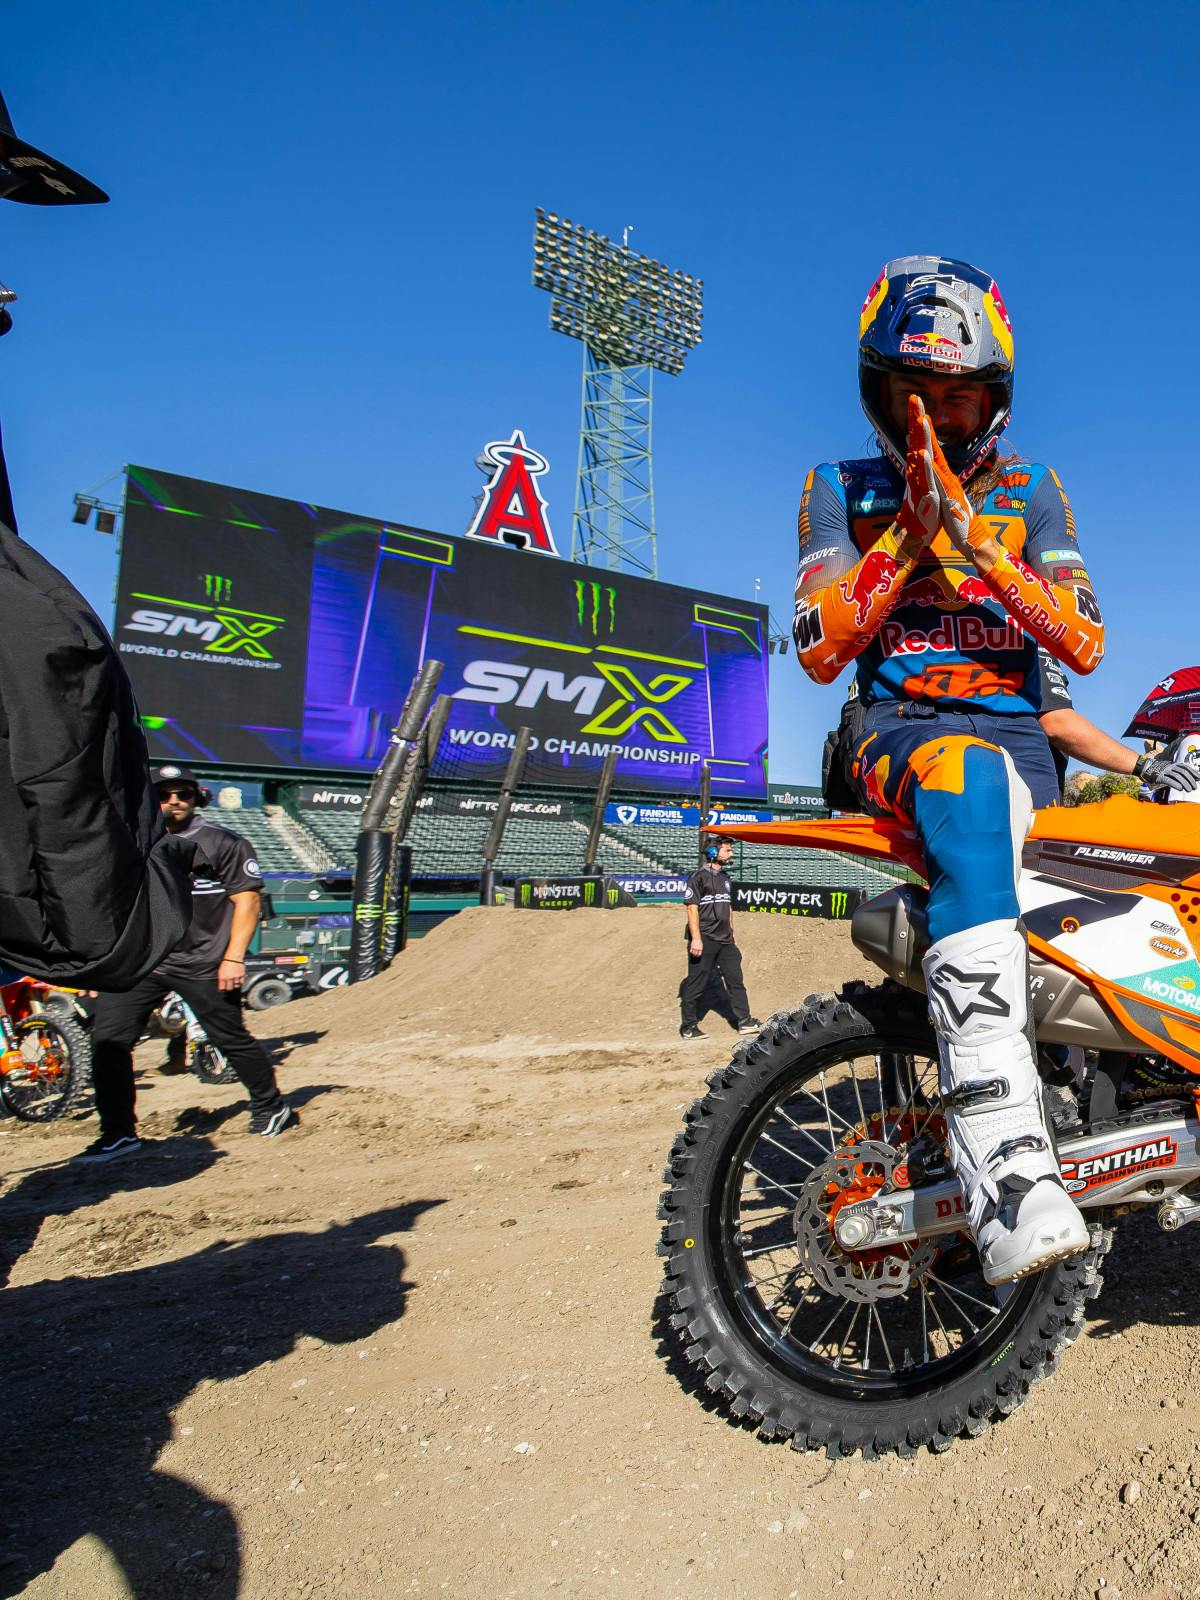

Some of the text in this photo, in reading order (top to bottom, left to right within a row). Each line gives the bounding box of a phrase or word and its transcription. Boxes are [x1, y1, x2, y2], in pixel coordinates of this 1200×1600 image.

[900, 344, 964, 360] Red Bull
[465, 429, 560, 557] A
[1001, 581, 1040, 620] Red
[1031, 608, 1068, 643] Bull
[123, 609, 278, 659] SMX
[879, 615, 955, 658] Red
[957, 615, 1025, 651] Bull
[119, 642, 282, 669] WORLD CHAMPIONSHIP
[450, 660, 693, 744] SMX
[450, 728, 701, 765] WORLD CHAMPIONSHIP
[772, 792, 824, 806] TEAM STOR
[640, 809, 683, 819] FANDUEL
[720, 813, 758, 823] FANDUEL
[1074, 846, 1156, 865] PLESSINGER
[533, 884, 581, 898] MONSTER
[737, 888, 822, 907] MONSTER
[750, 906, 809, 917] ENERGY
[1152, 940, 1172, 953] Twin
[1089, 1156, 1174, 1187] CHAINWHEELS
